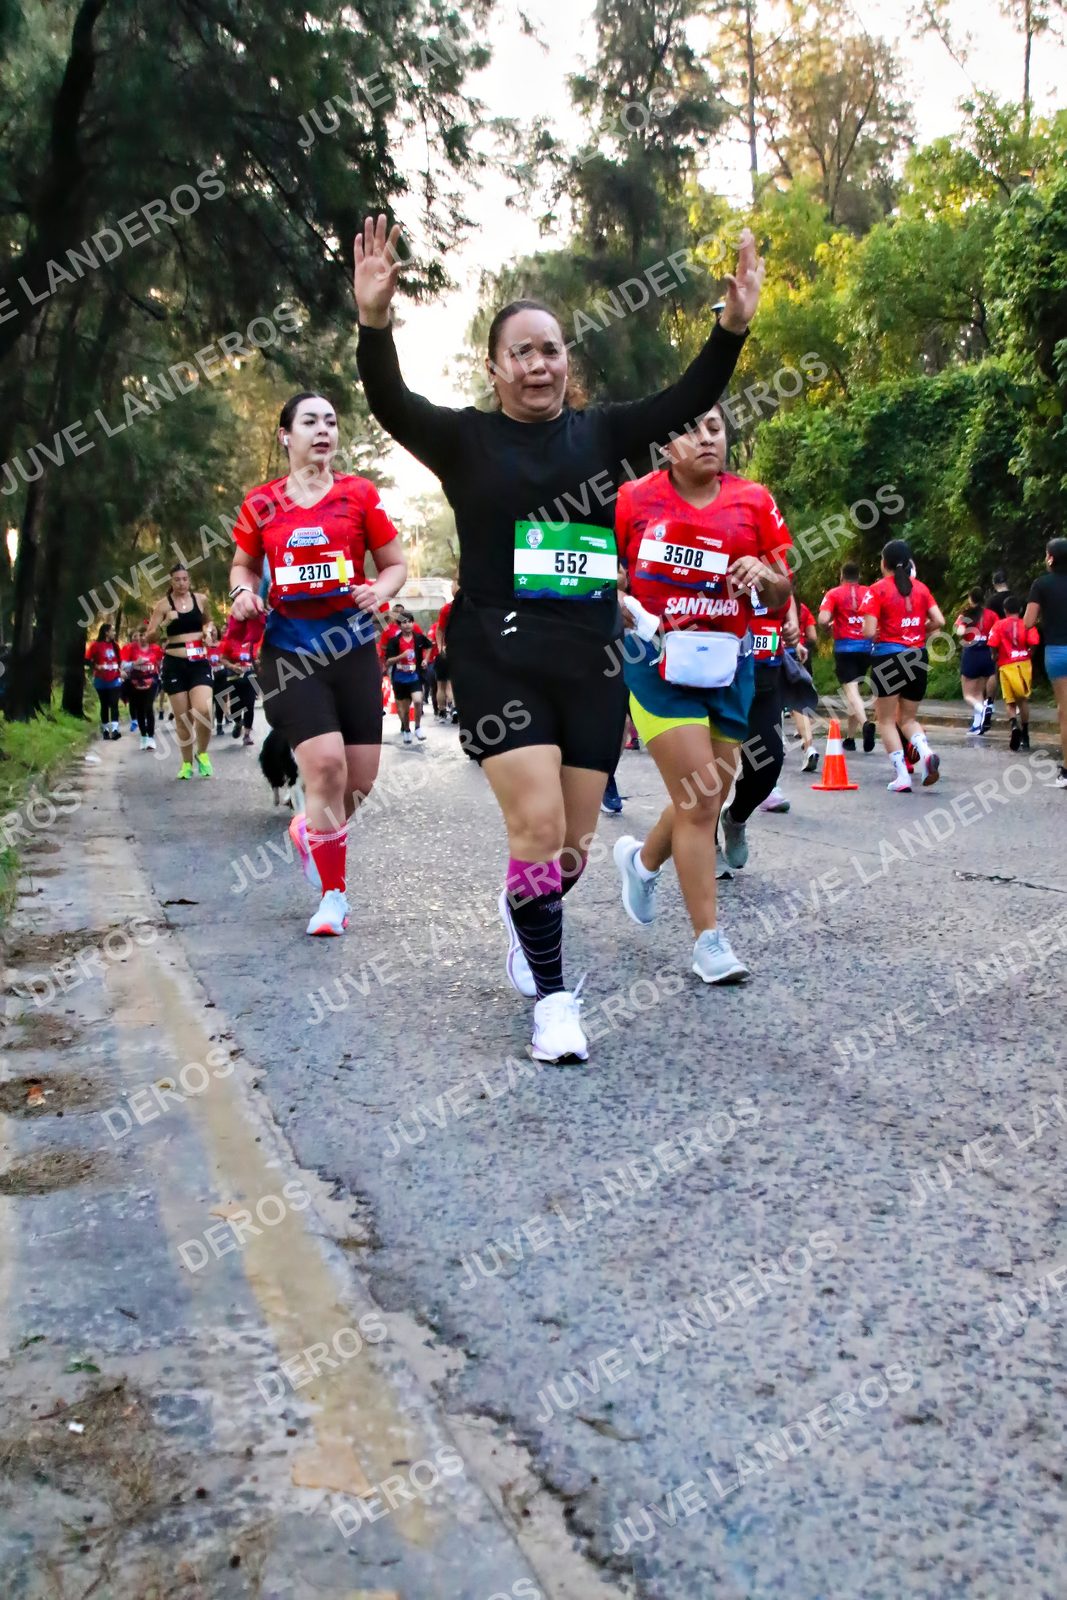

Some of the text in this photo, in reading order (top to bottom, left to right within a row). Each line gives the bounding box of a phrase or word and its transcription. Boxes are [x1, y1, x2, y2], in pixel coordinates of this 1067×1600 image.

[554, 552, 587, 575] 552
[663, 545, 704, 568] 3508
[299, 564, 331, 581] 2370
[664, 597, 739, 617] SANTIAGO
